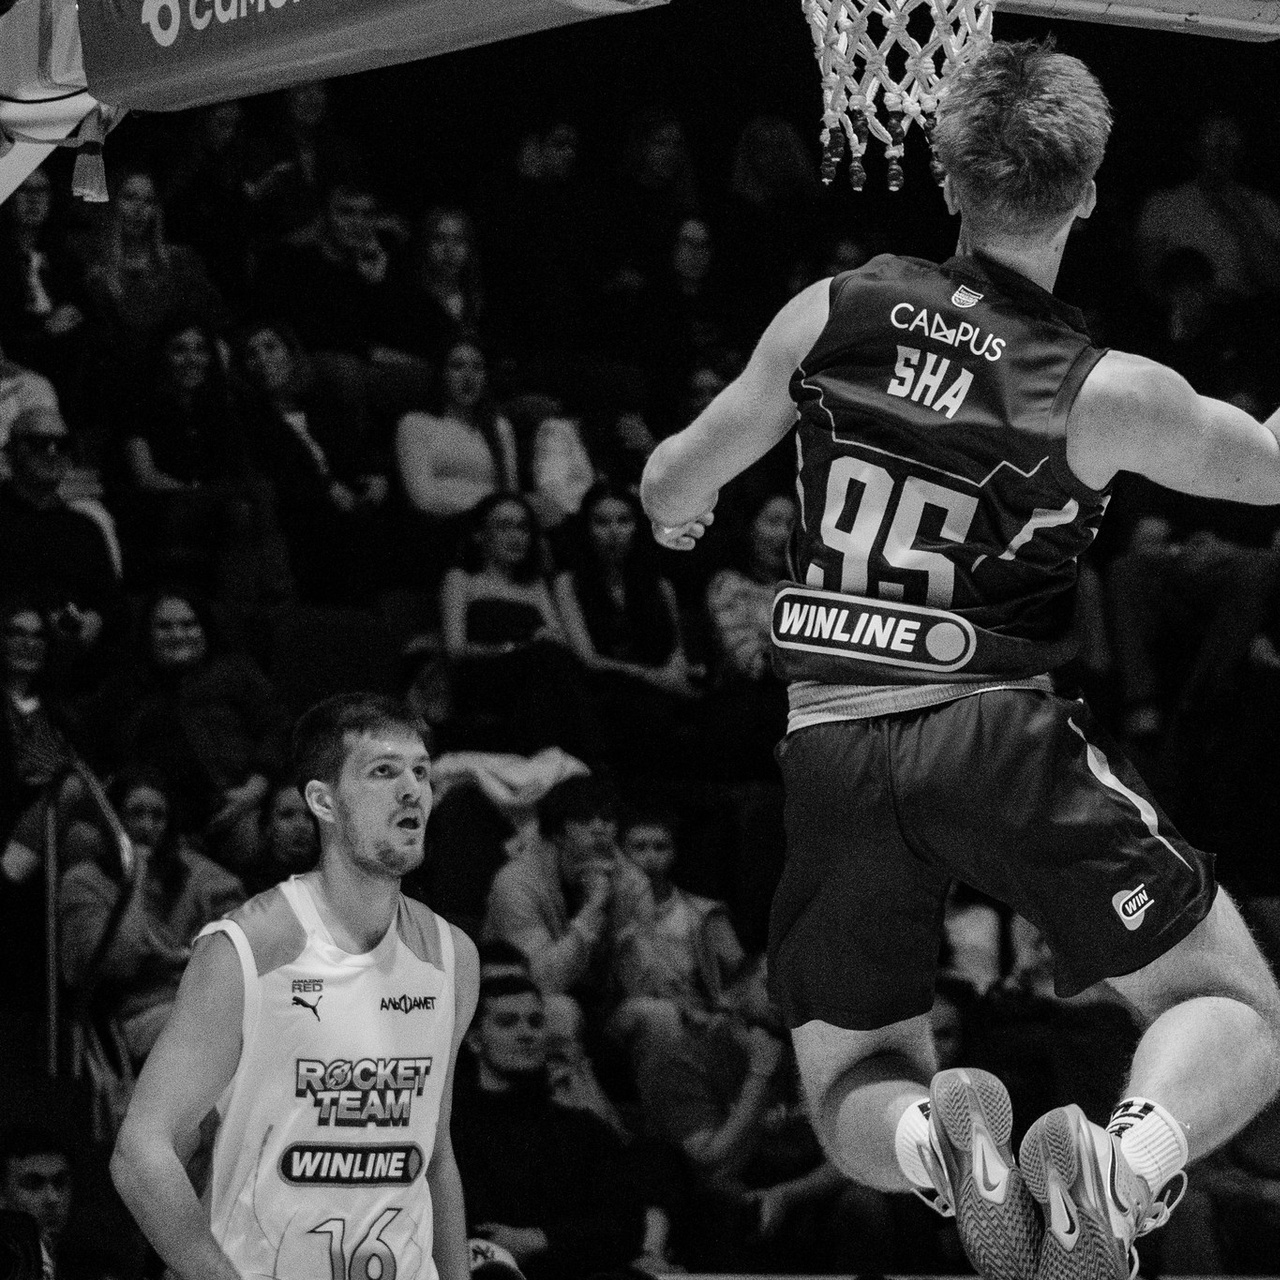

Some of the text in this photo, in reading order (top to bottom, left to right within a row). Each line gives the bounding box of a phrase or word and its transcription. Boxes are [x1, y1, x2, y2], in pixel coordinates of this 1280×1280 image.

[886, 345, 975, 419] SHA
[806, 455, 980, 608] 95
[779, 601, 921, 653] WINLINE
[1124, 889, 1149, 915] WIN
[291, 983, 323, 993] RED
[295, 1056, 433, 1097] ROCKET
[313, 1090, 413, 1127] TEAM
[290, 1150, 407, 1179] WINLINE
